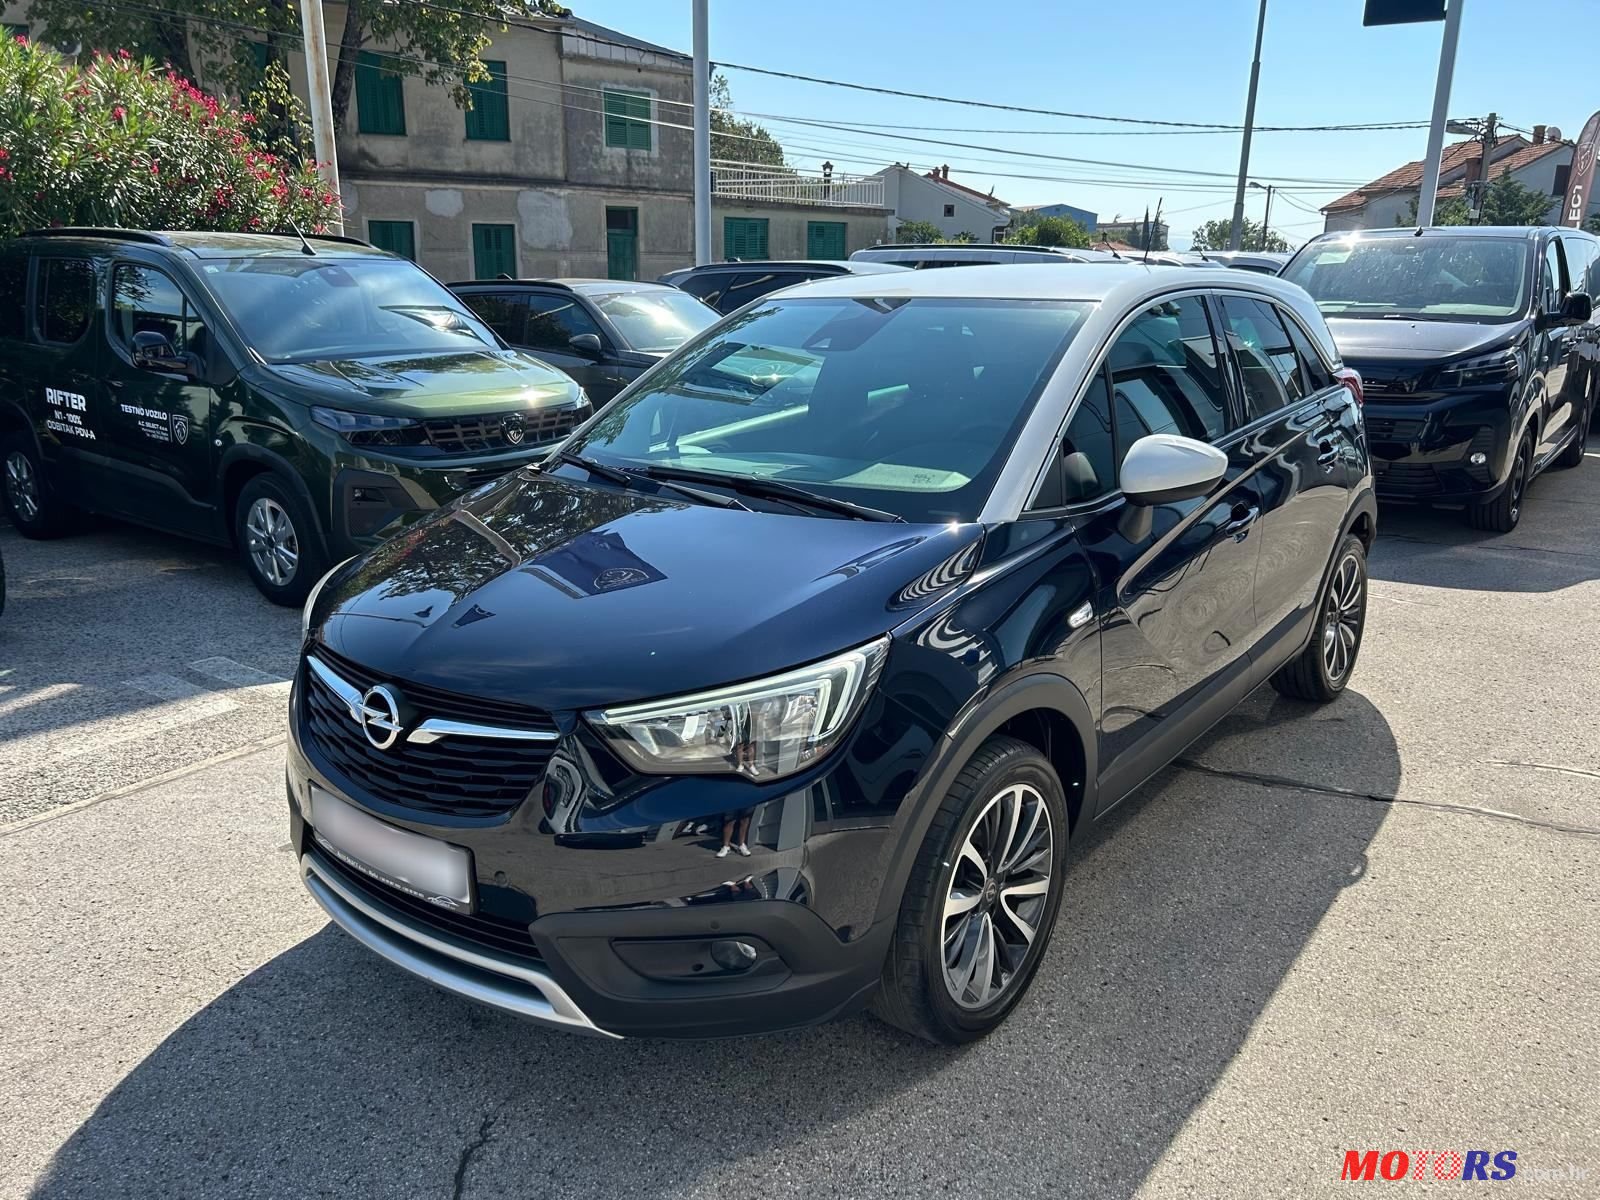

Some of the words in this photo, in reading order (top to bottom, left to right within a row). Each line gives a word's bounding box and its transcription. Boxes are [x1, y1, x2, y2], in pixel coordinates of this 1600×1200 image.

[45, 387, 87, 411] RIFTER
[66, 413, 82, 425] 100%
[120, 403, 145, 416] TESTNO
[144, 408, 168, 421] VOZILO
[47, 419, 75, 435] ODBITAK
[74, 426, 96, 440] PDV-A
